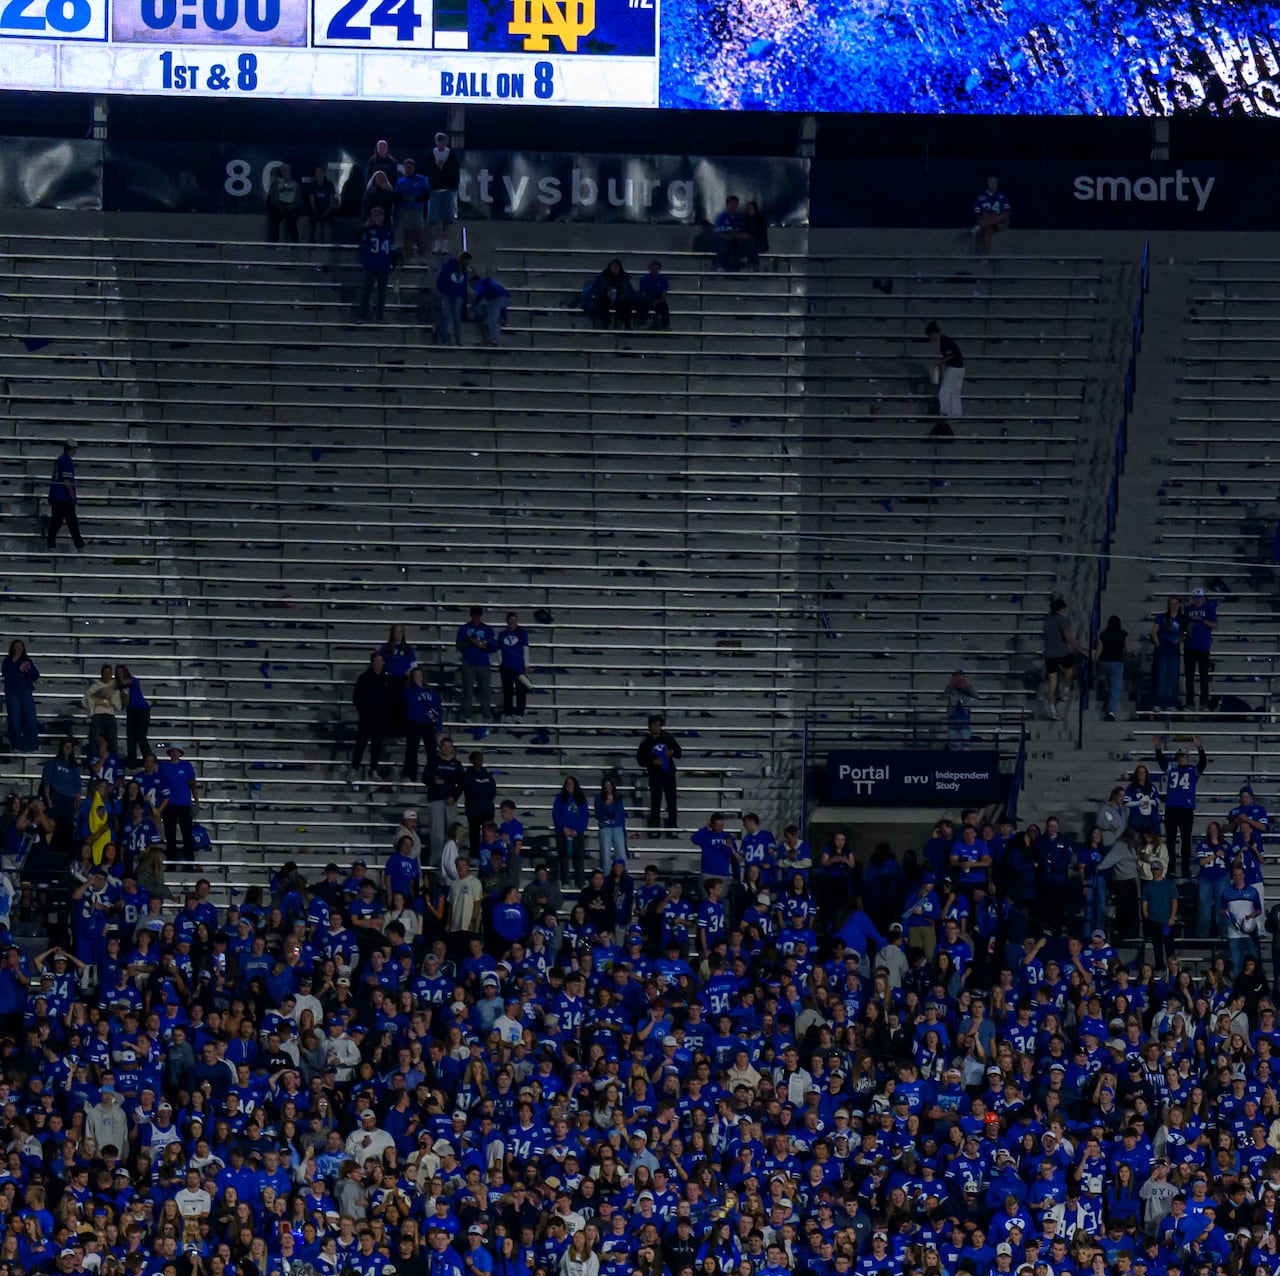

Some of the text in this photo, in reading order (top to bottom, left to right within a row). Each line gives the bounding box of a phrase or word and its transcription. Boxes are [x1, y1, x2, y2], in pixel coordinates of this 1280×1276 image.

[159, 51, 257, 91] 1ST & 8
[440, 61, 554, 99] BALL ON 8
[459, 166, 695, 218] ttysburg
[1073, 171, 1215, 211] smarty
[370, 238, 389, 254] 34
[839, 765, 890, 780] Portal
[904, 775, 929, 785] BYU
[934, 770, 990, 781] Independent
[1171, 772, 1191, 790] 34
[853, 780, 875, 795] TT
[934, 781, 961, 792] Study
[562, 1011, 582, 1030] 34
[1015, 1036, 1036, 1055] 34
